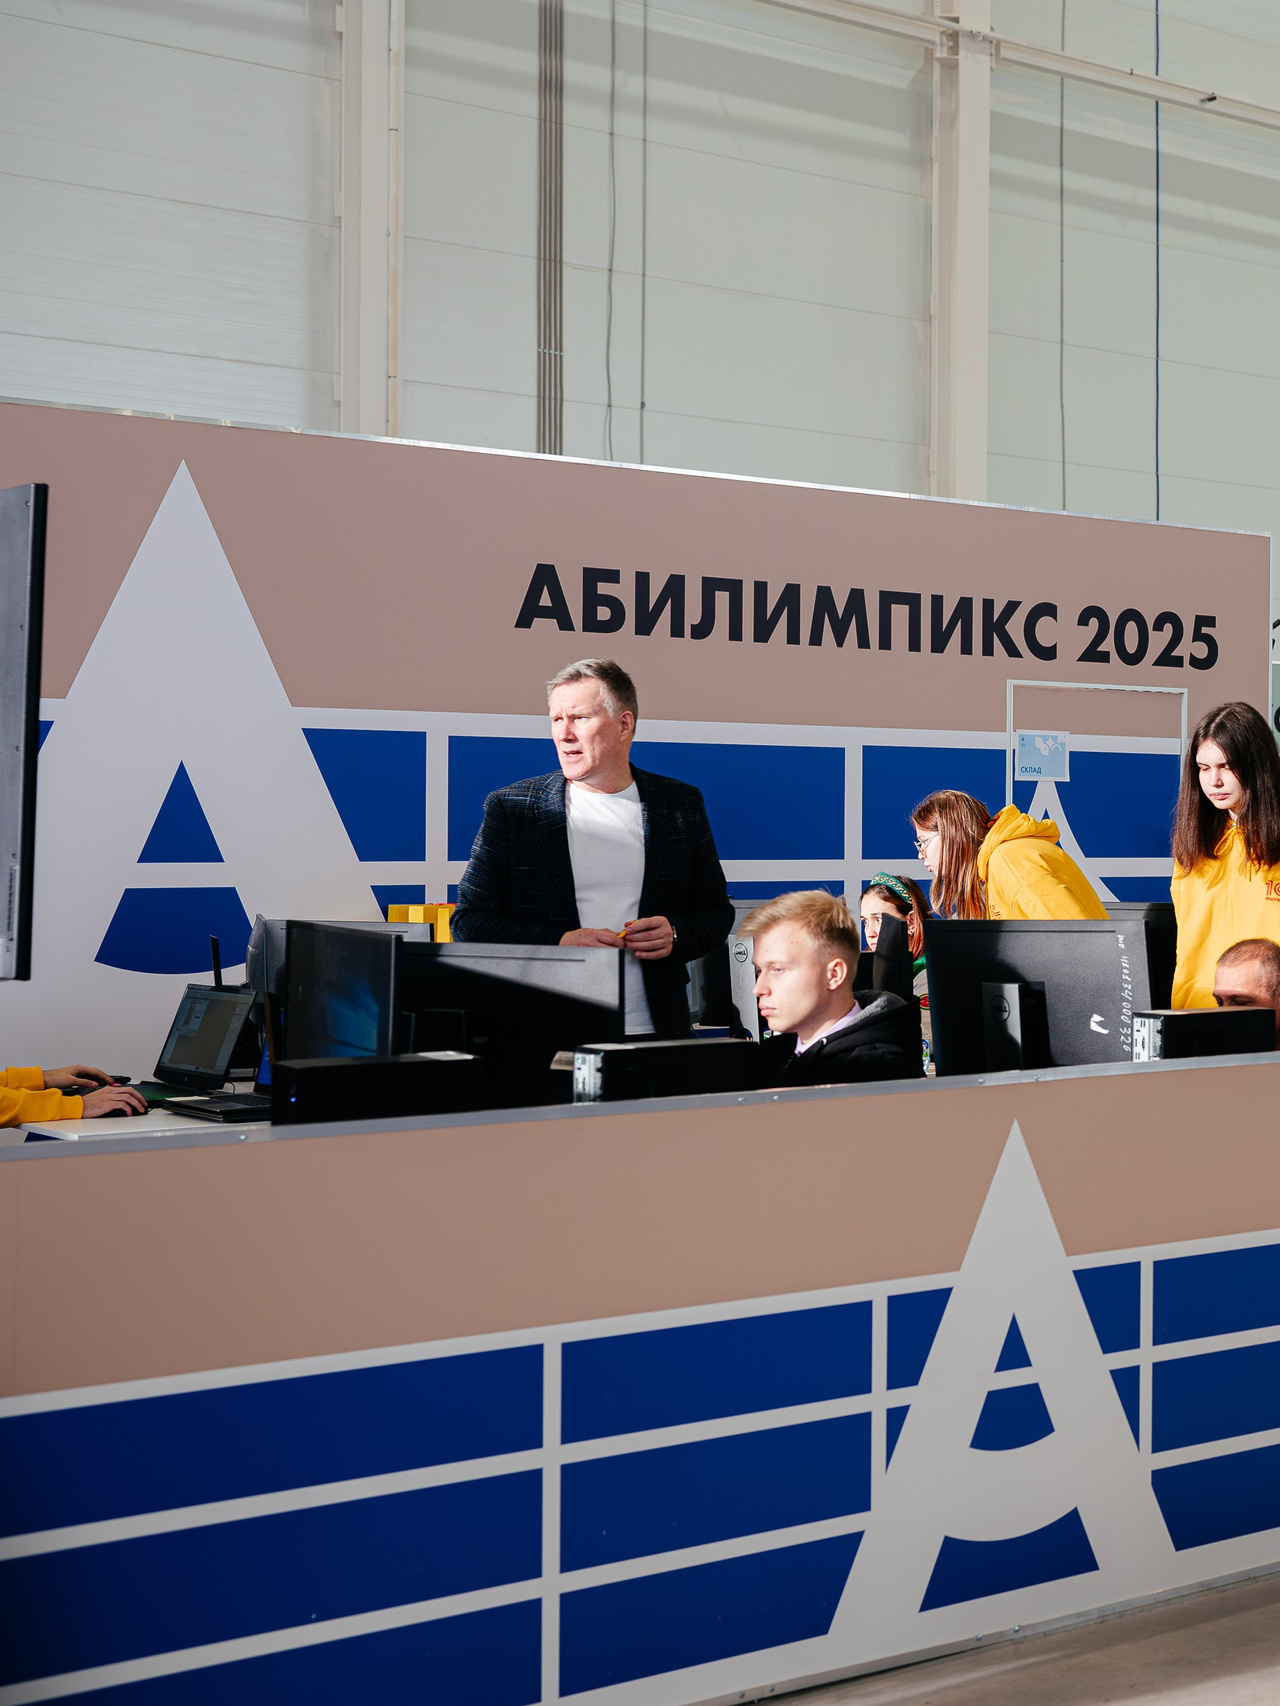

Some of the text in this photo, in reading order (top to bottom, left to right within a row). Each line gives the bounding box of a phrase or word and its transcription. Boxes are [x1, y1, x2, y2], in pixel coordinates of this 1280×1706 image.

[514, 563, 1218, 670] АБИЛИМПИКС 2025
[1020, 766, 1042, 775] СКЛАД
